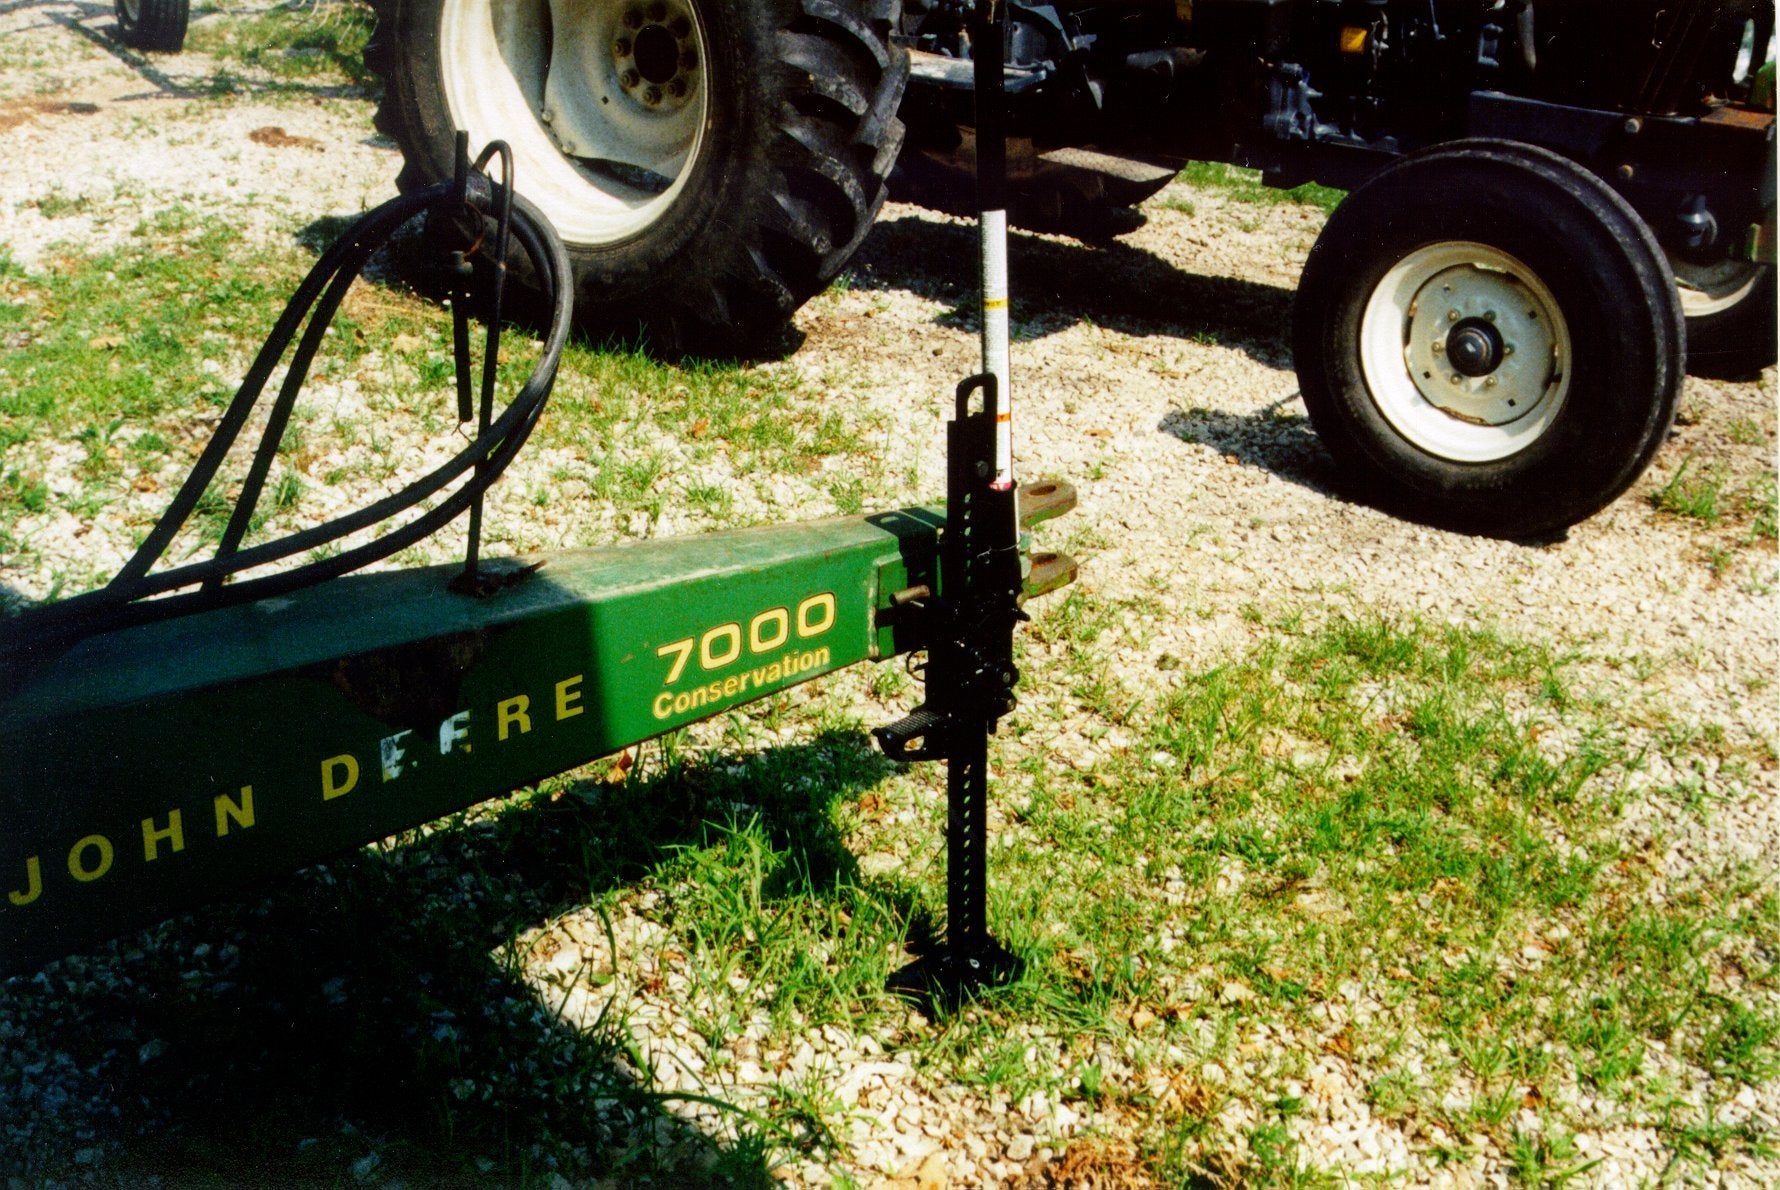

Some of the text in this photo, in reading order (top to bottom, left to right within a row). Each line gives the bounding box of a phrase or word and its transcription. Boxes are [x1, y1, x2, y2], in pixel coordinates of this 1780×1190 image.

[652, 646, 830, 720] Conservation
[656, 591, 836, 686] 7000
[8, 784, 256, 907] JOHN
